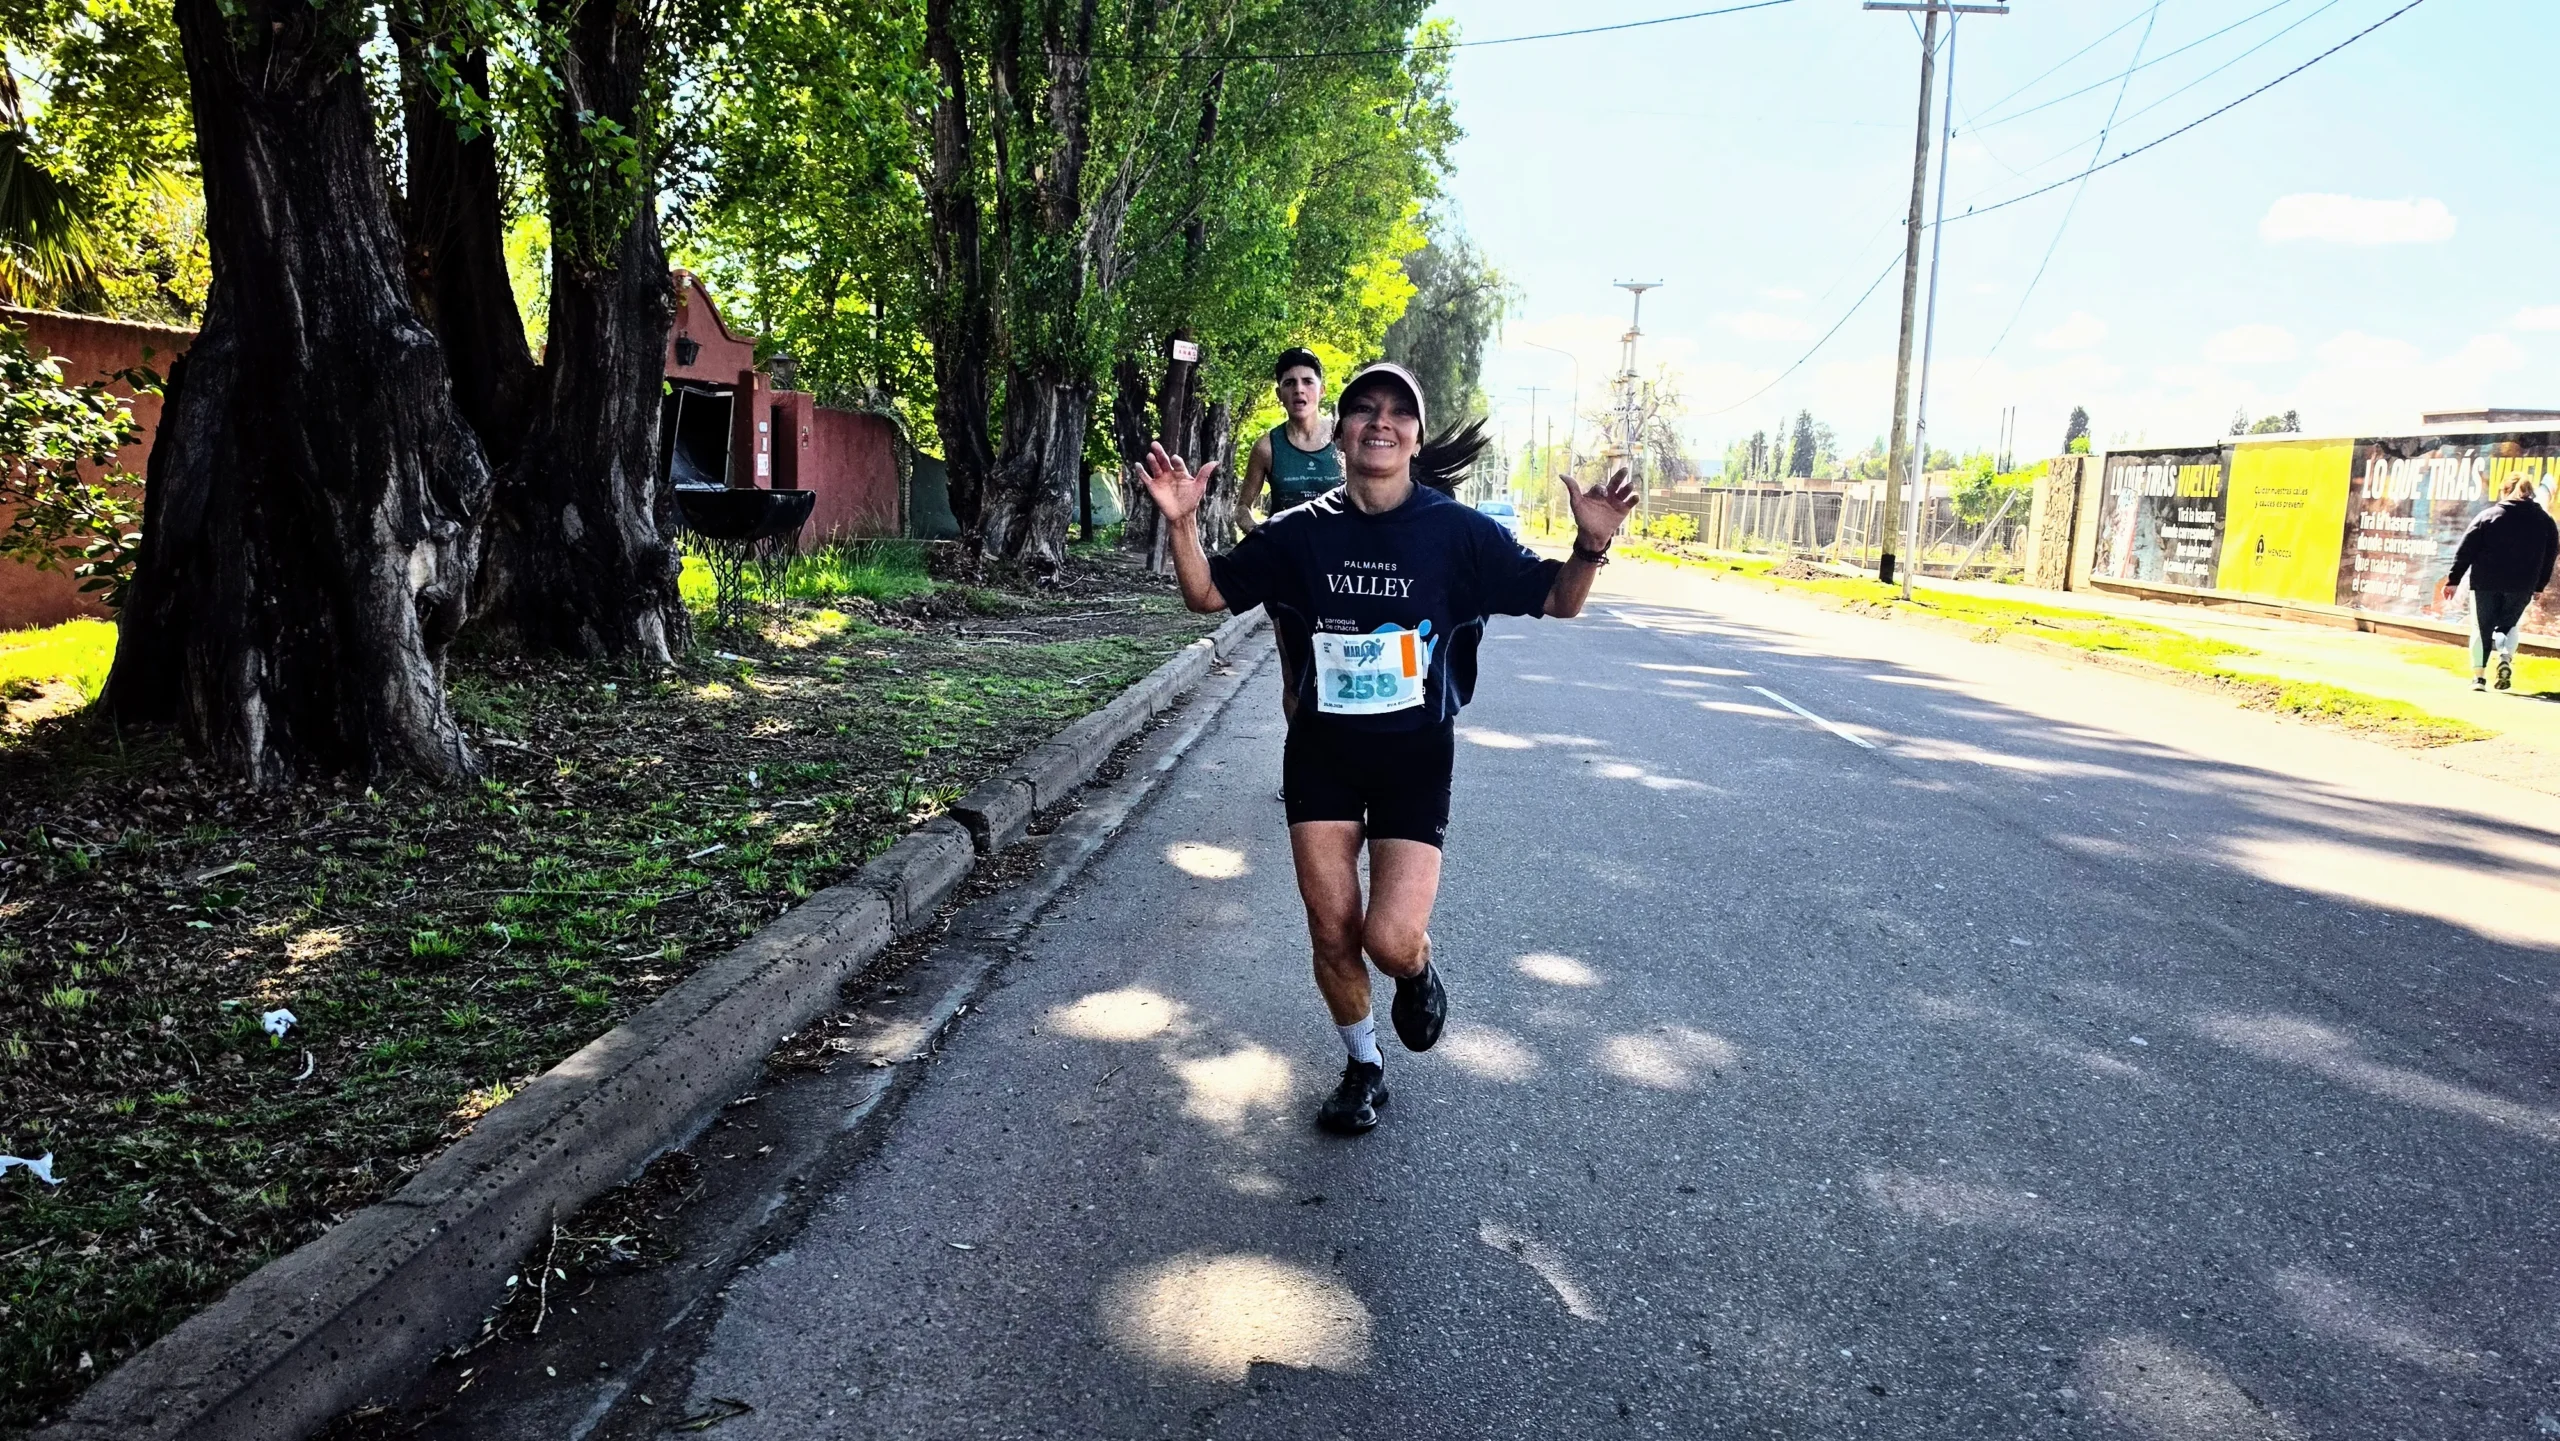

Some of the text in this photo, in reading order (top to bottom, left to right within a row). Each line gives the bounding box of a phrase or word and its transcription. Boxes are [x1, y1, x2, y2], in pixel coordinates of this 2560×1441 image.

[2110, 459, 2222, 497] LO QUE TIRÁS VUELVE
[2363, 458, 2387, 499] LO
[2390, 457, 2425, 500] QUE
[2427, 449, 2486, 501] TIRÁS
[2360, 511, 2376, 530] Tirá
[2385, 512, 2416, 532] basura
[2357, 532, 2438, 557] donde corresponde
[1344, 560, 1397, 571] PALMARES
[2354, 554, 2407, 578] Que nada tape
[1326, 574, 1414, 598] VALLEY
[1337, 673, 1398, 700] 258
